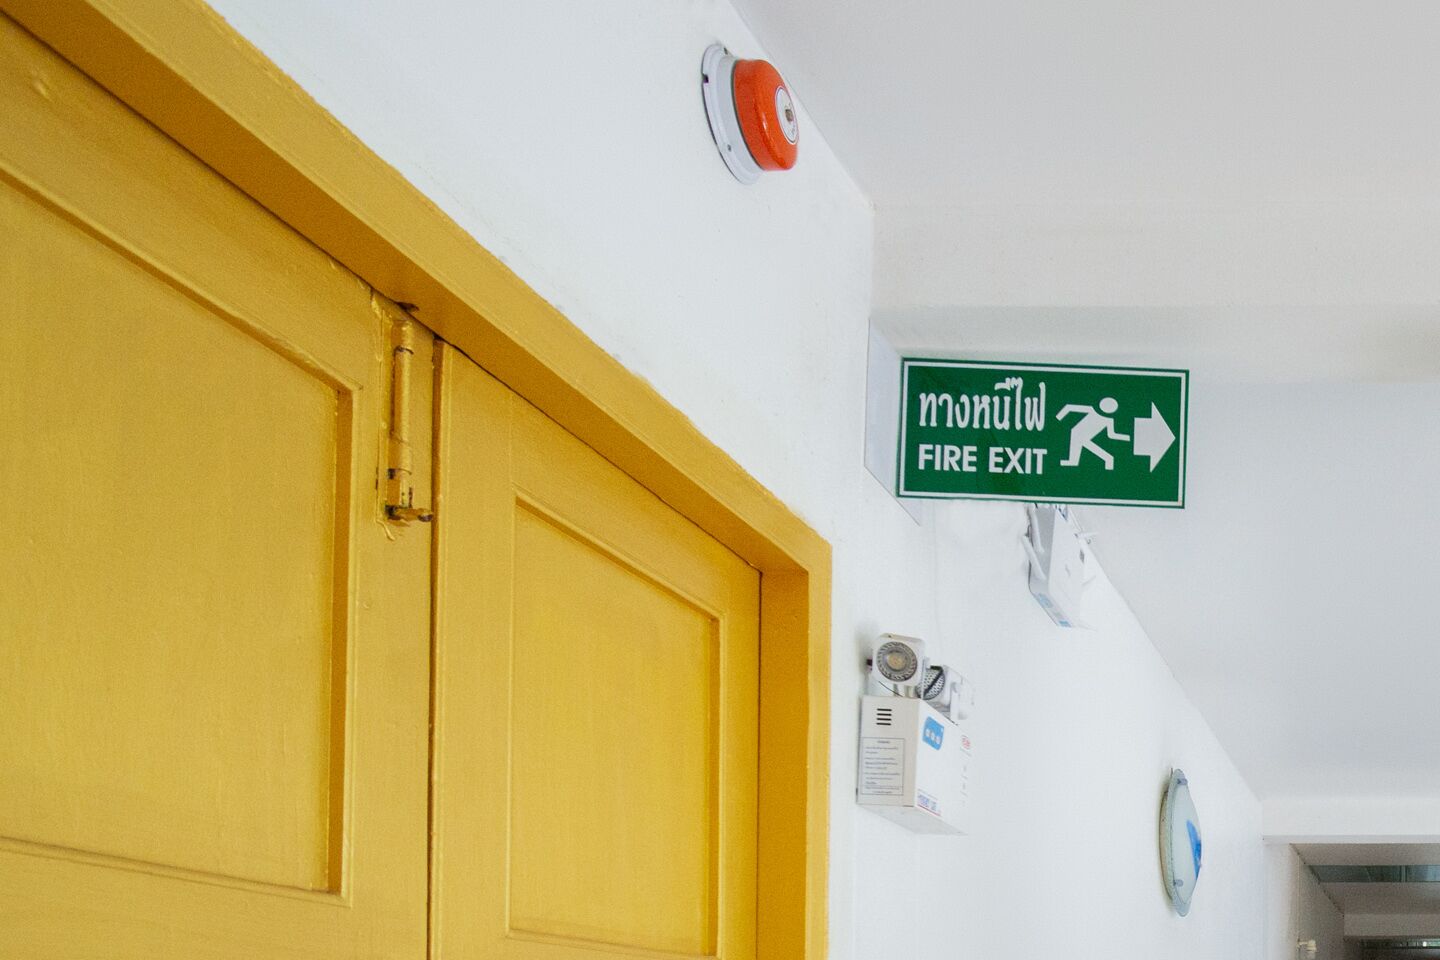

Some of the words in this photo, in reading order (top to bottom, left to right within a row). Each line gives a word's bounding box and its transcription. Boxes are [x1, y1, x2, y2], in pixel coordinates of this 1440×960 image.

[918, 376, 1046, 431] ทางหนีไฟ
[918, 444, 977, 472] FIRE
[988, 447, 1047, 475] EXIT
